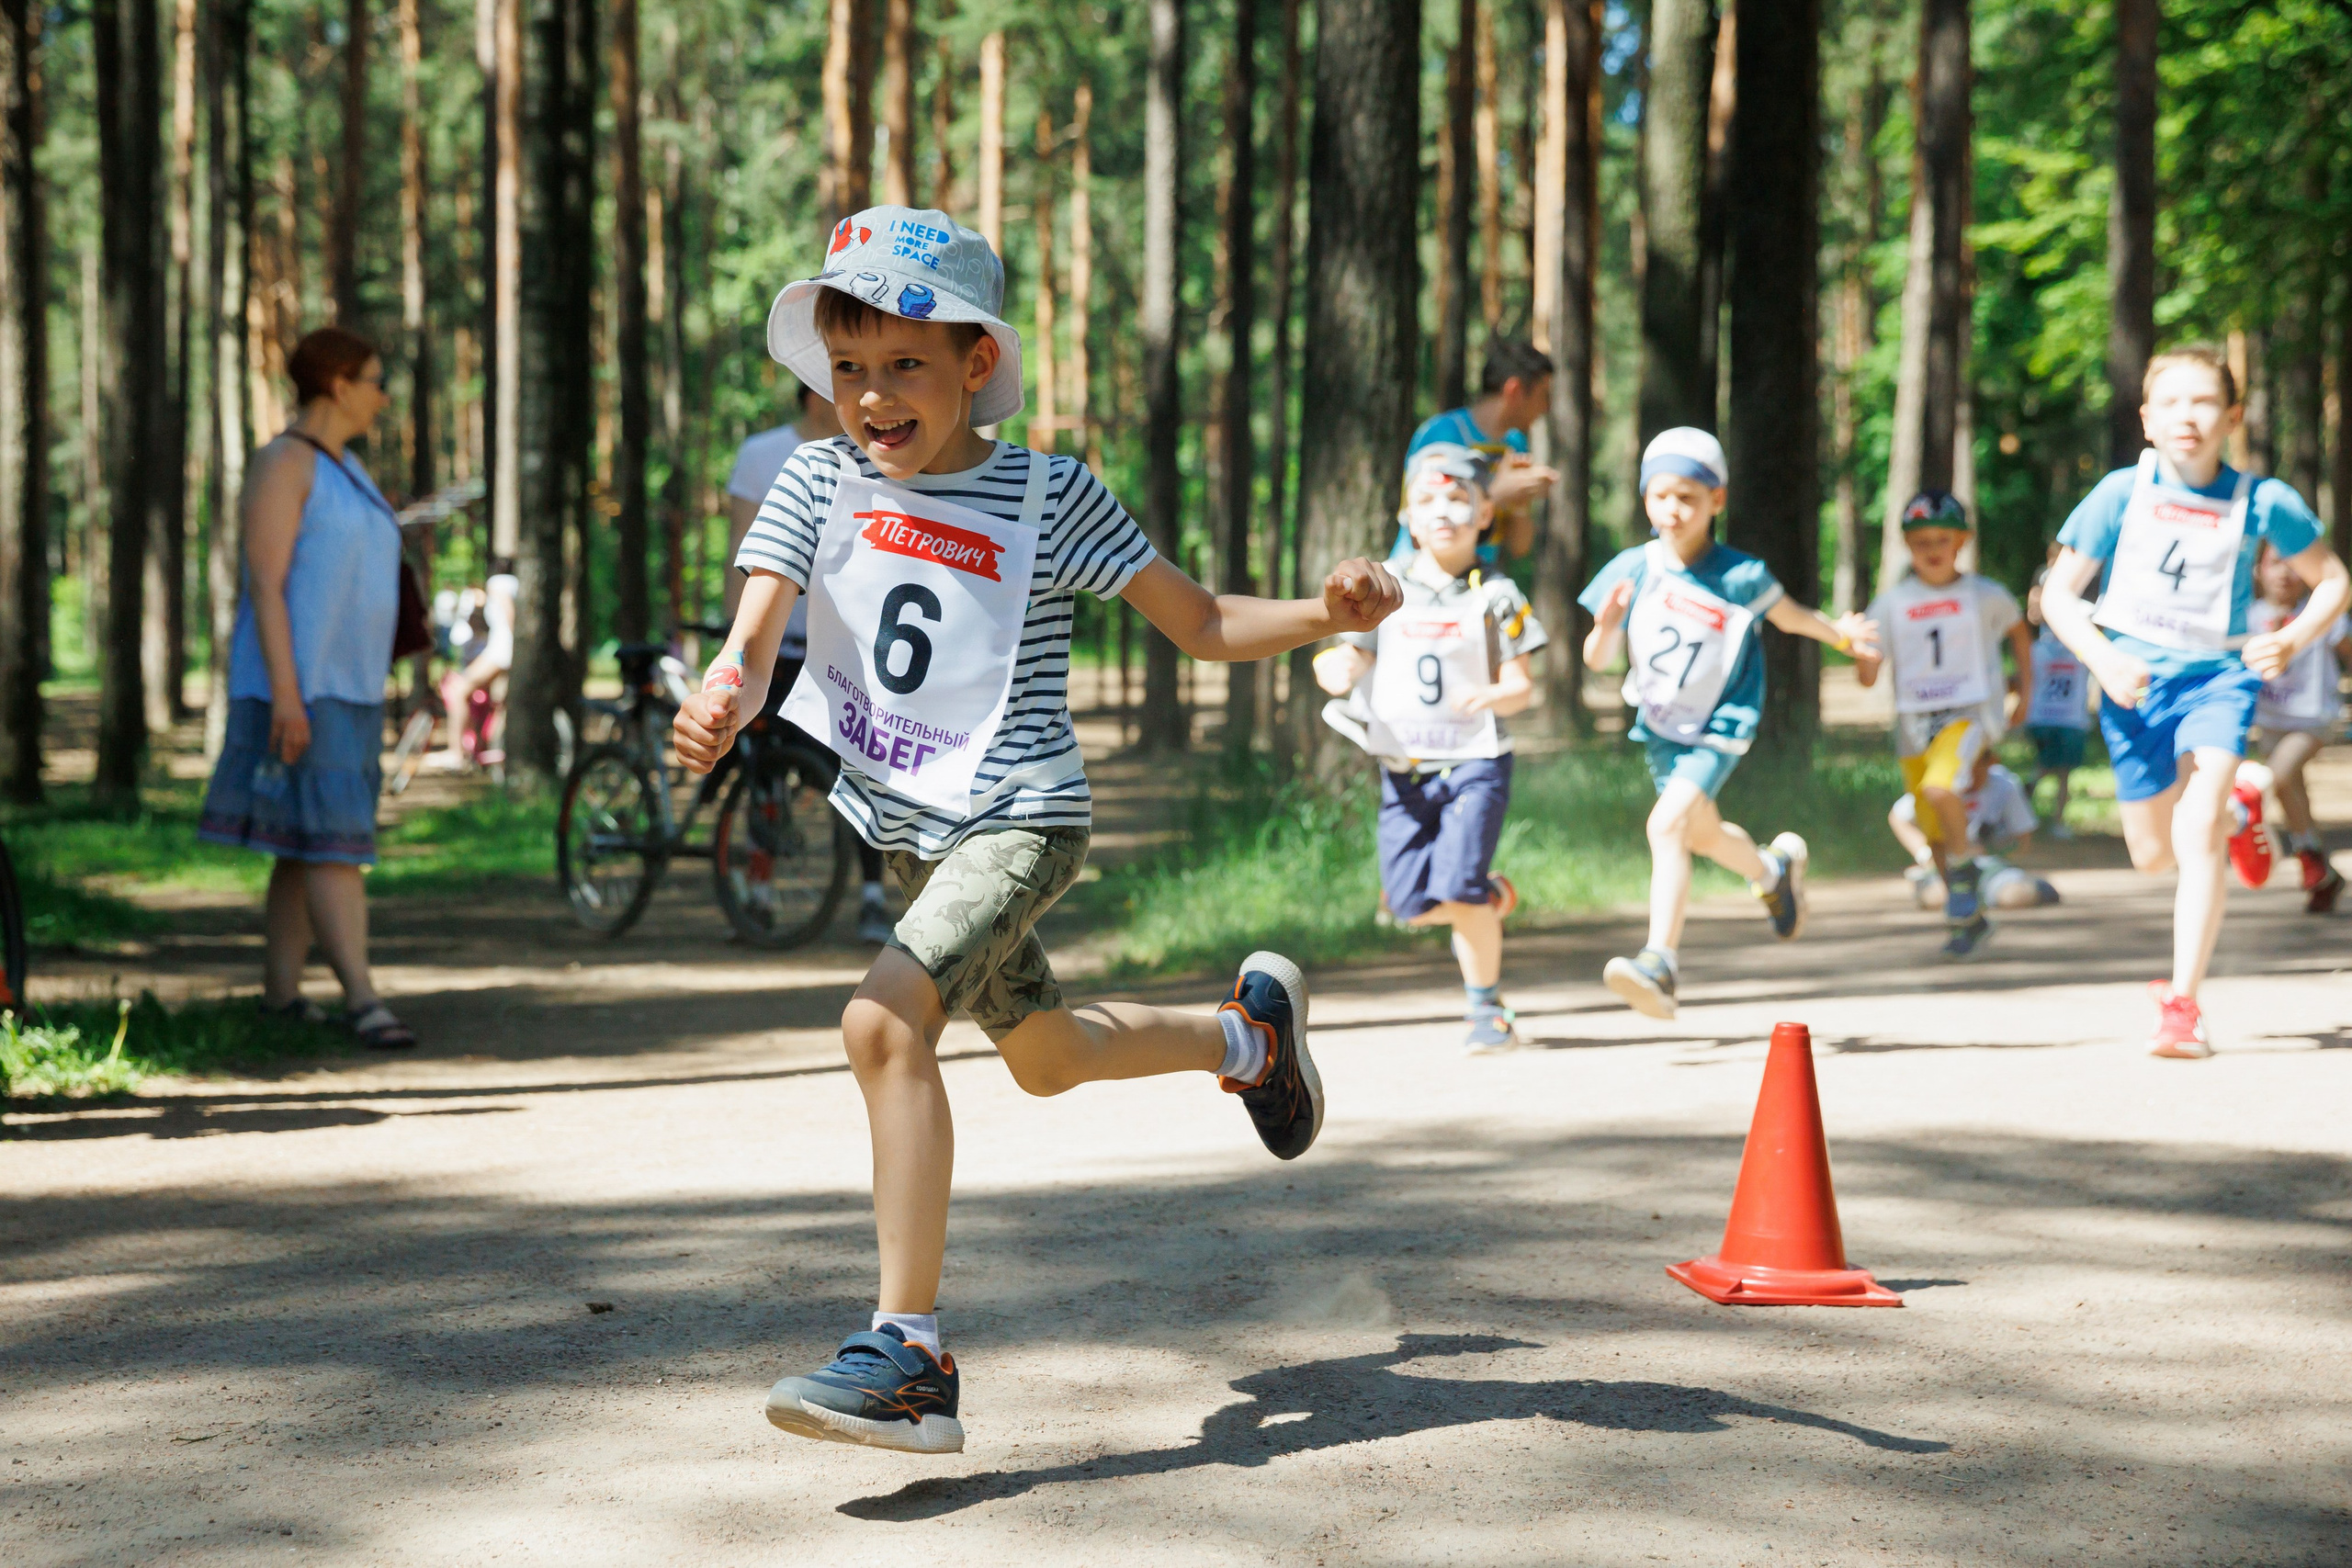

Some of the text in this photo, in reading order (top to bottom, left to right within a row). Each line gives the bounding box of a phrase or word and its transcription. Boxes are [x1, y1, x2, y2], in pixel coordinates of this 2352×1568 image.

[889, 220, 950, 243] I NEED
[895, 235, 929, 250] MORE
[892, 245, 940, 271] SPACE
[878, 515, 987, 568] ПЕТРОВИЧ
[2157, 539, 2187, 591] 4
[873, 582, 943, 695] 6
[1649, 626, 1703, 690] 21
[1925, 627, 1941, 669] 1
[1417, 653, 1443, 705] 9
[827, 663, 970, 752] БЛАГОТВОРИТЕЛЬНЫЙ
[838, 701, 937, 778] ЗАБЕГ
